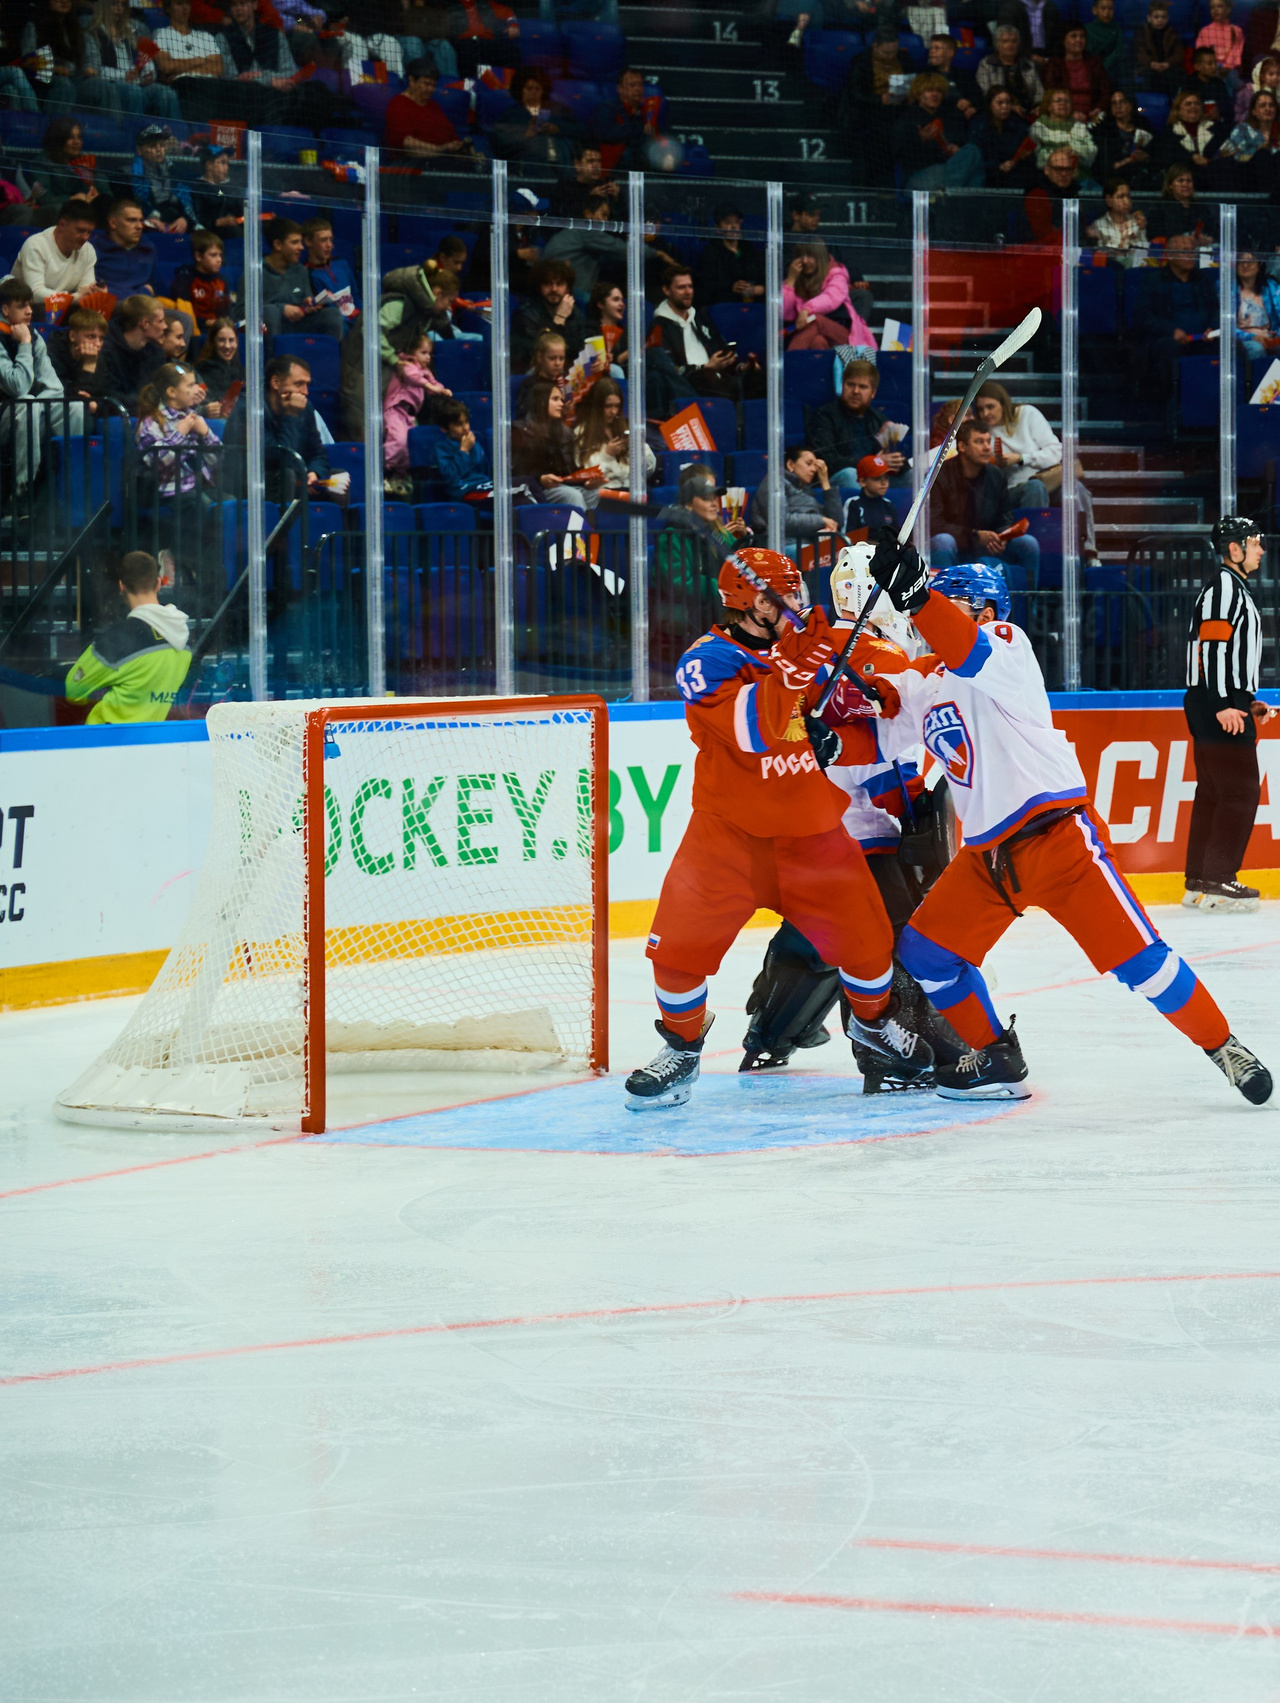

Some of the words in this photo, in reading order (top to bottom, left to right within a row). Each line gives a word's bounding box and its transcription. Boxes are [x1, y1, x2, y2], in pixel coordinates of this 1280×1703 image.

[713, 21, 738, 42] 14
[752, 79, 780, 103] 13
[799, 138, 827, 160] 12
[847, 202, 868, 224] 11
[675, 659, 707, 700] 33
